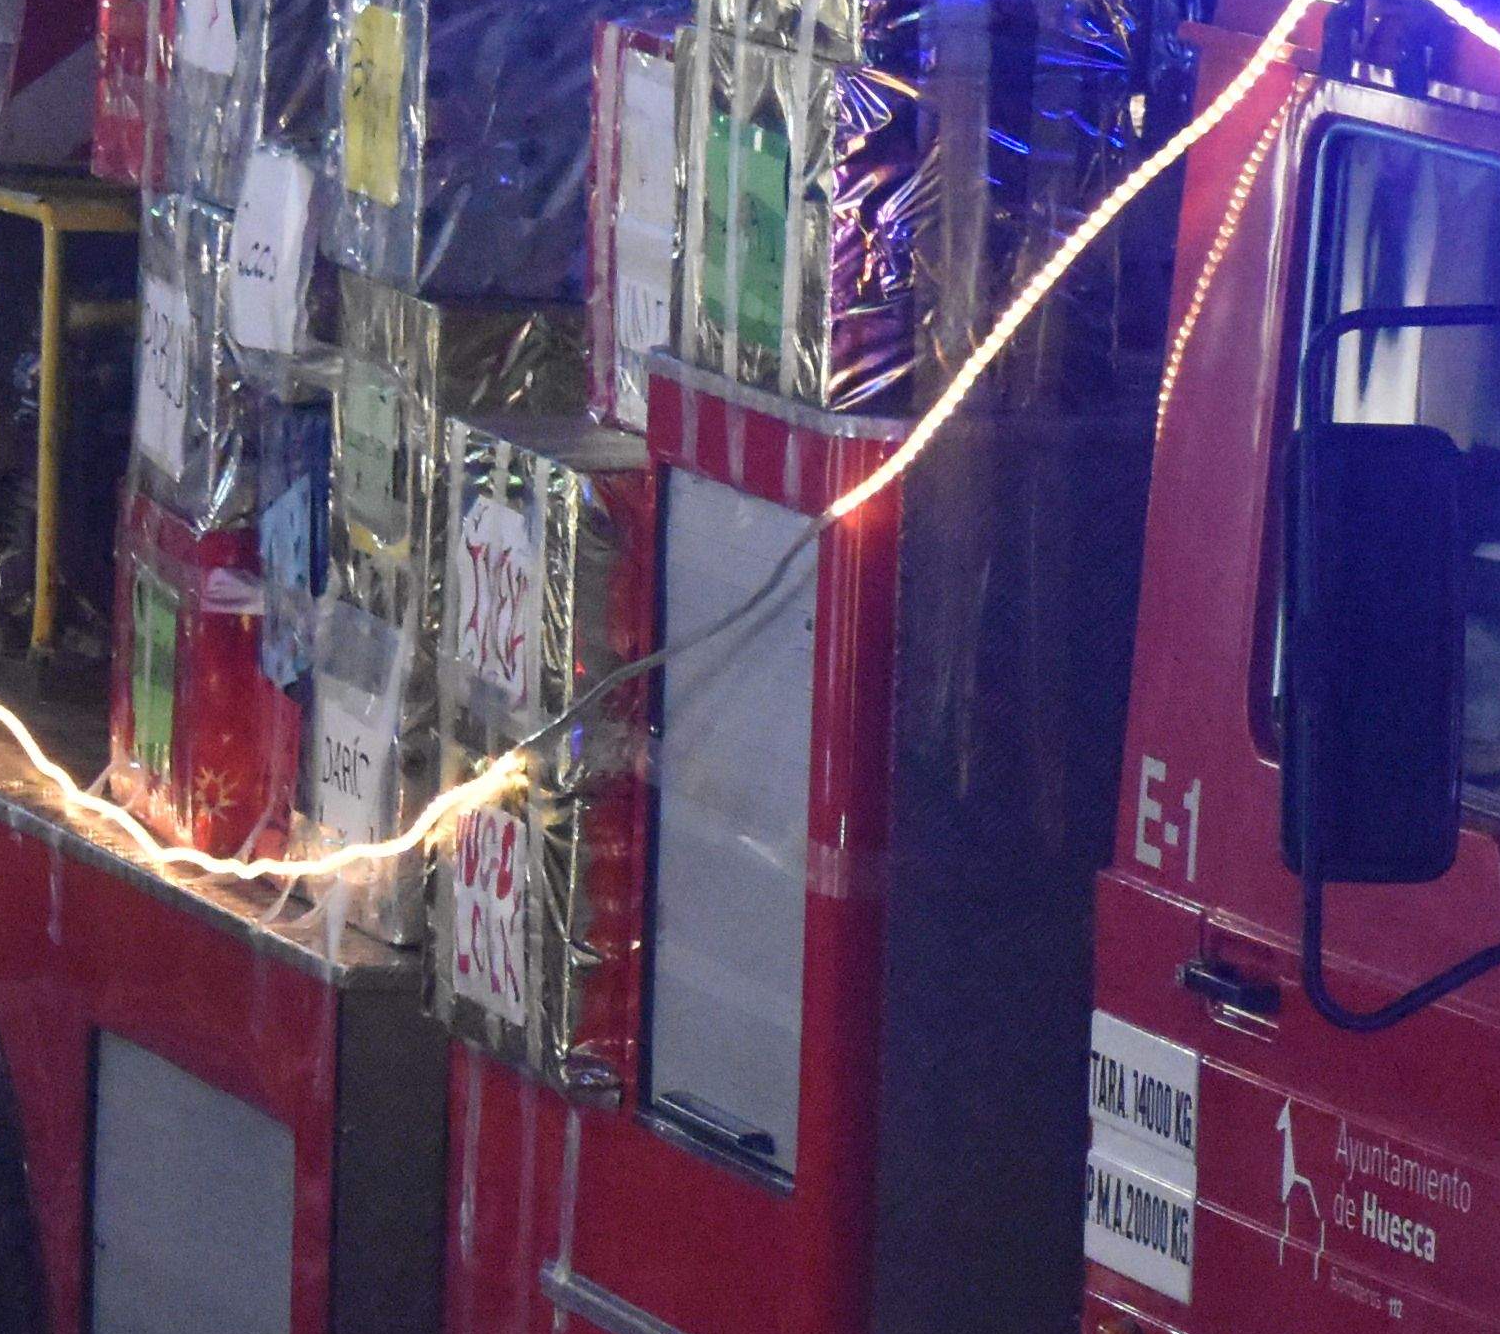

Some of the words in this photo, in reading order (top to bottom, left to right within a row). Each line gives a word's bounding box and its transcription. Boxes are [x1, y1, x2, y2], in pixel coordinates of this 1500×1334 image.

[1135, 754, 1201, 882] E-1
[1133, 1069, 1172, 1139] 14000
[1334, 1118, 1472, 1214] Ayuntamiento
[1333, 1182, 1356, 1230] de
[1362, 1190, 1436, 1263] Huesca
